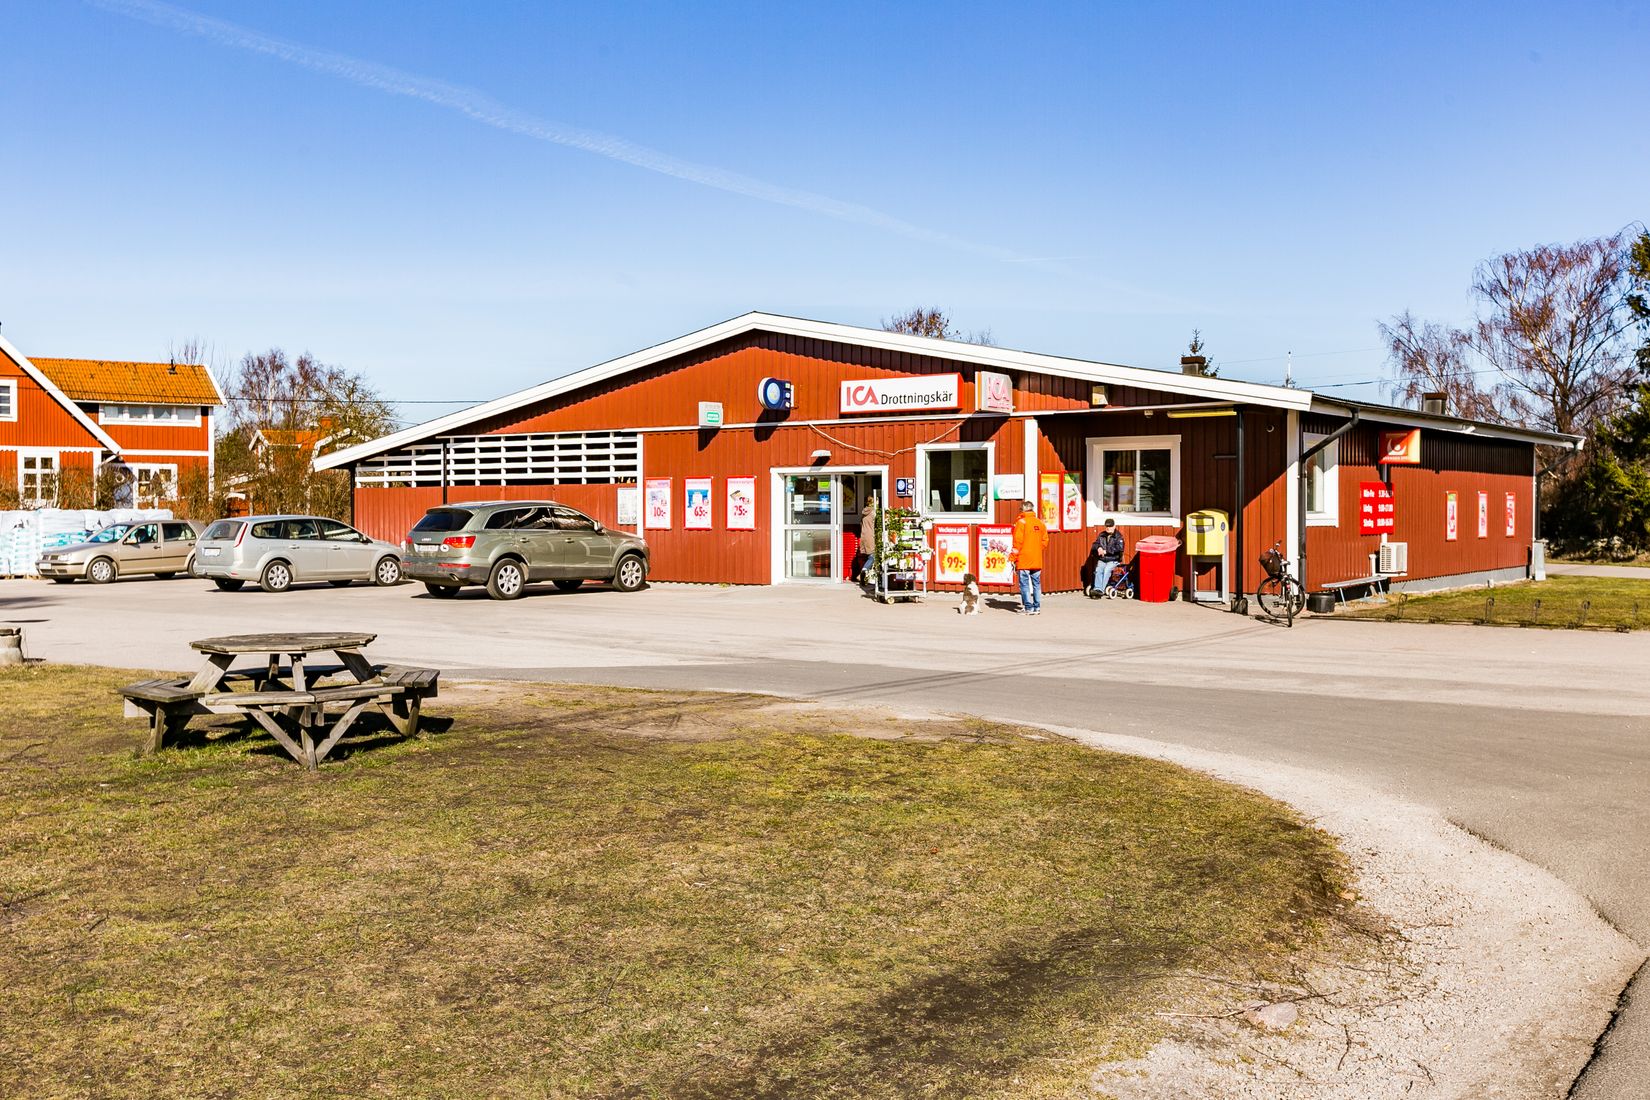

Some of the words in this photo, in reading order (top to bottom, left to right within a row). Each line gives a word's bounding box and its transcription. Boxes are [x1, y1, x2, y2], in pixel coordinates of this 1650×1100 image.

[846, 385, 879, 406] ICA
[881, 391, 953, 406] Drottningskär
[694, 506, 708, 517] 65:-
[946, 556, 966, 568] 99:-
